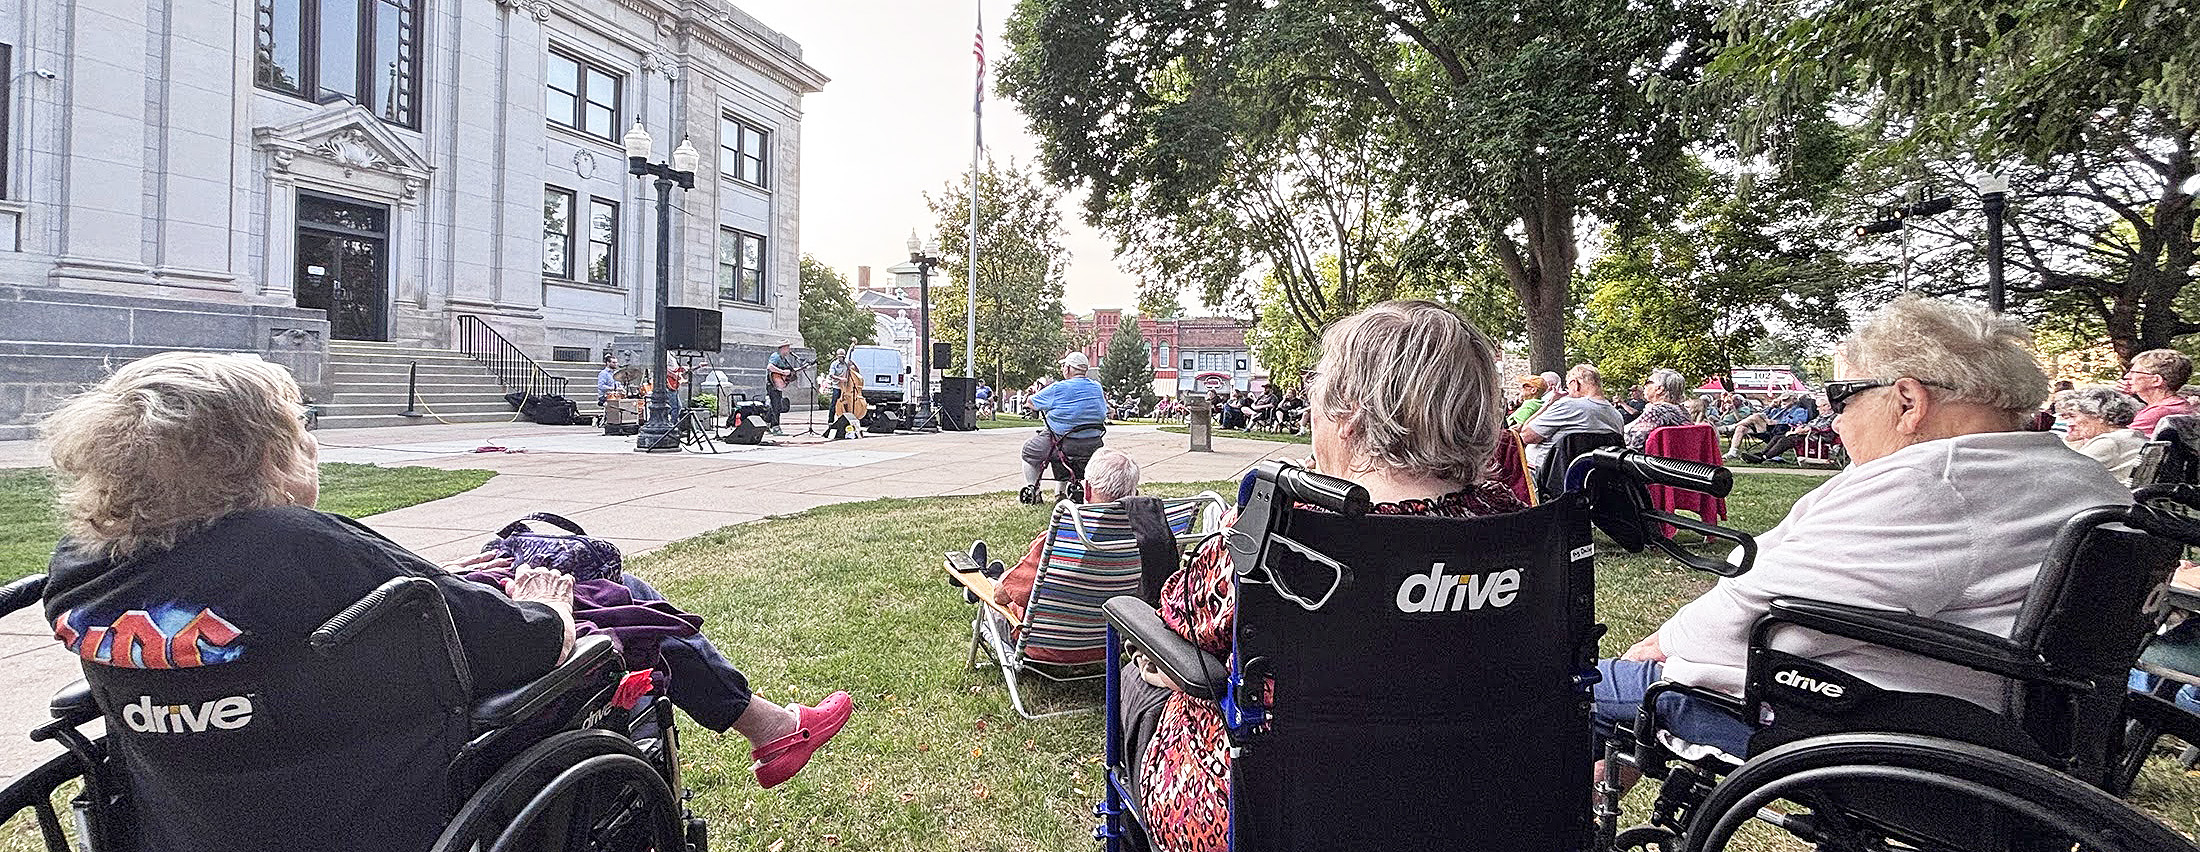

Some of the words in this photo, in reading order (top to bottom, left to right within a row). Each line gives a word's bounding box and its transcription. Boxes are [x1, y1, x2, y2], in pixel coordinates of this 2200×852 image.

[1754, 372, 1771, 380] 102
[1396, 562, 1521, 613] drive
[1774, 669, 1844, 698] drive
[122, 696, 254, 733] drive
[582, 701, 614, 730] drive
